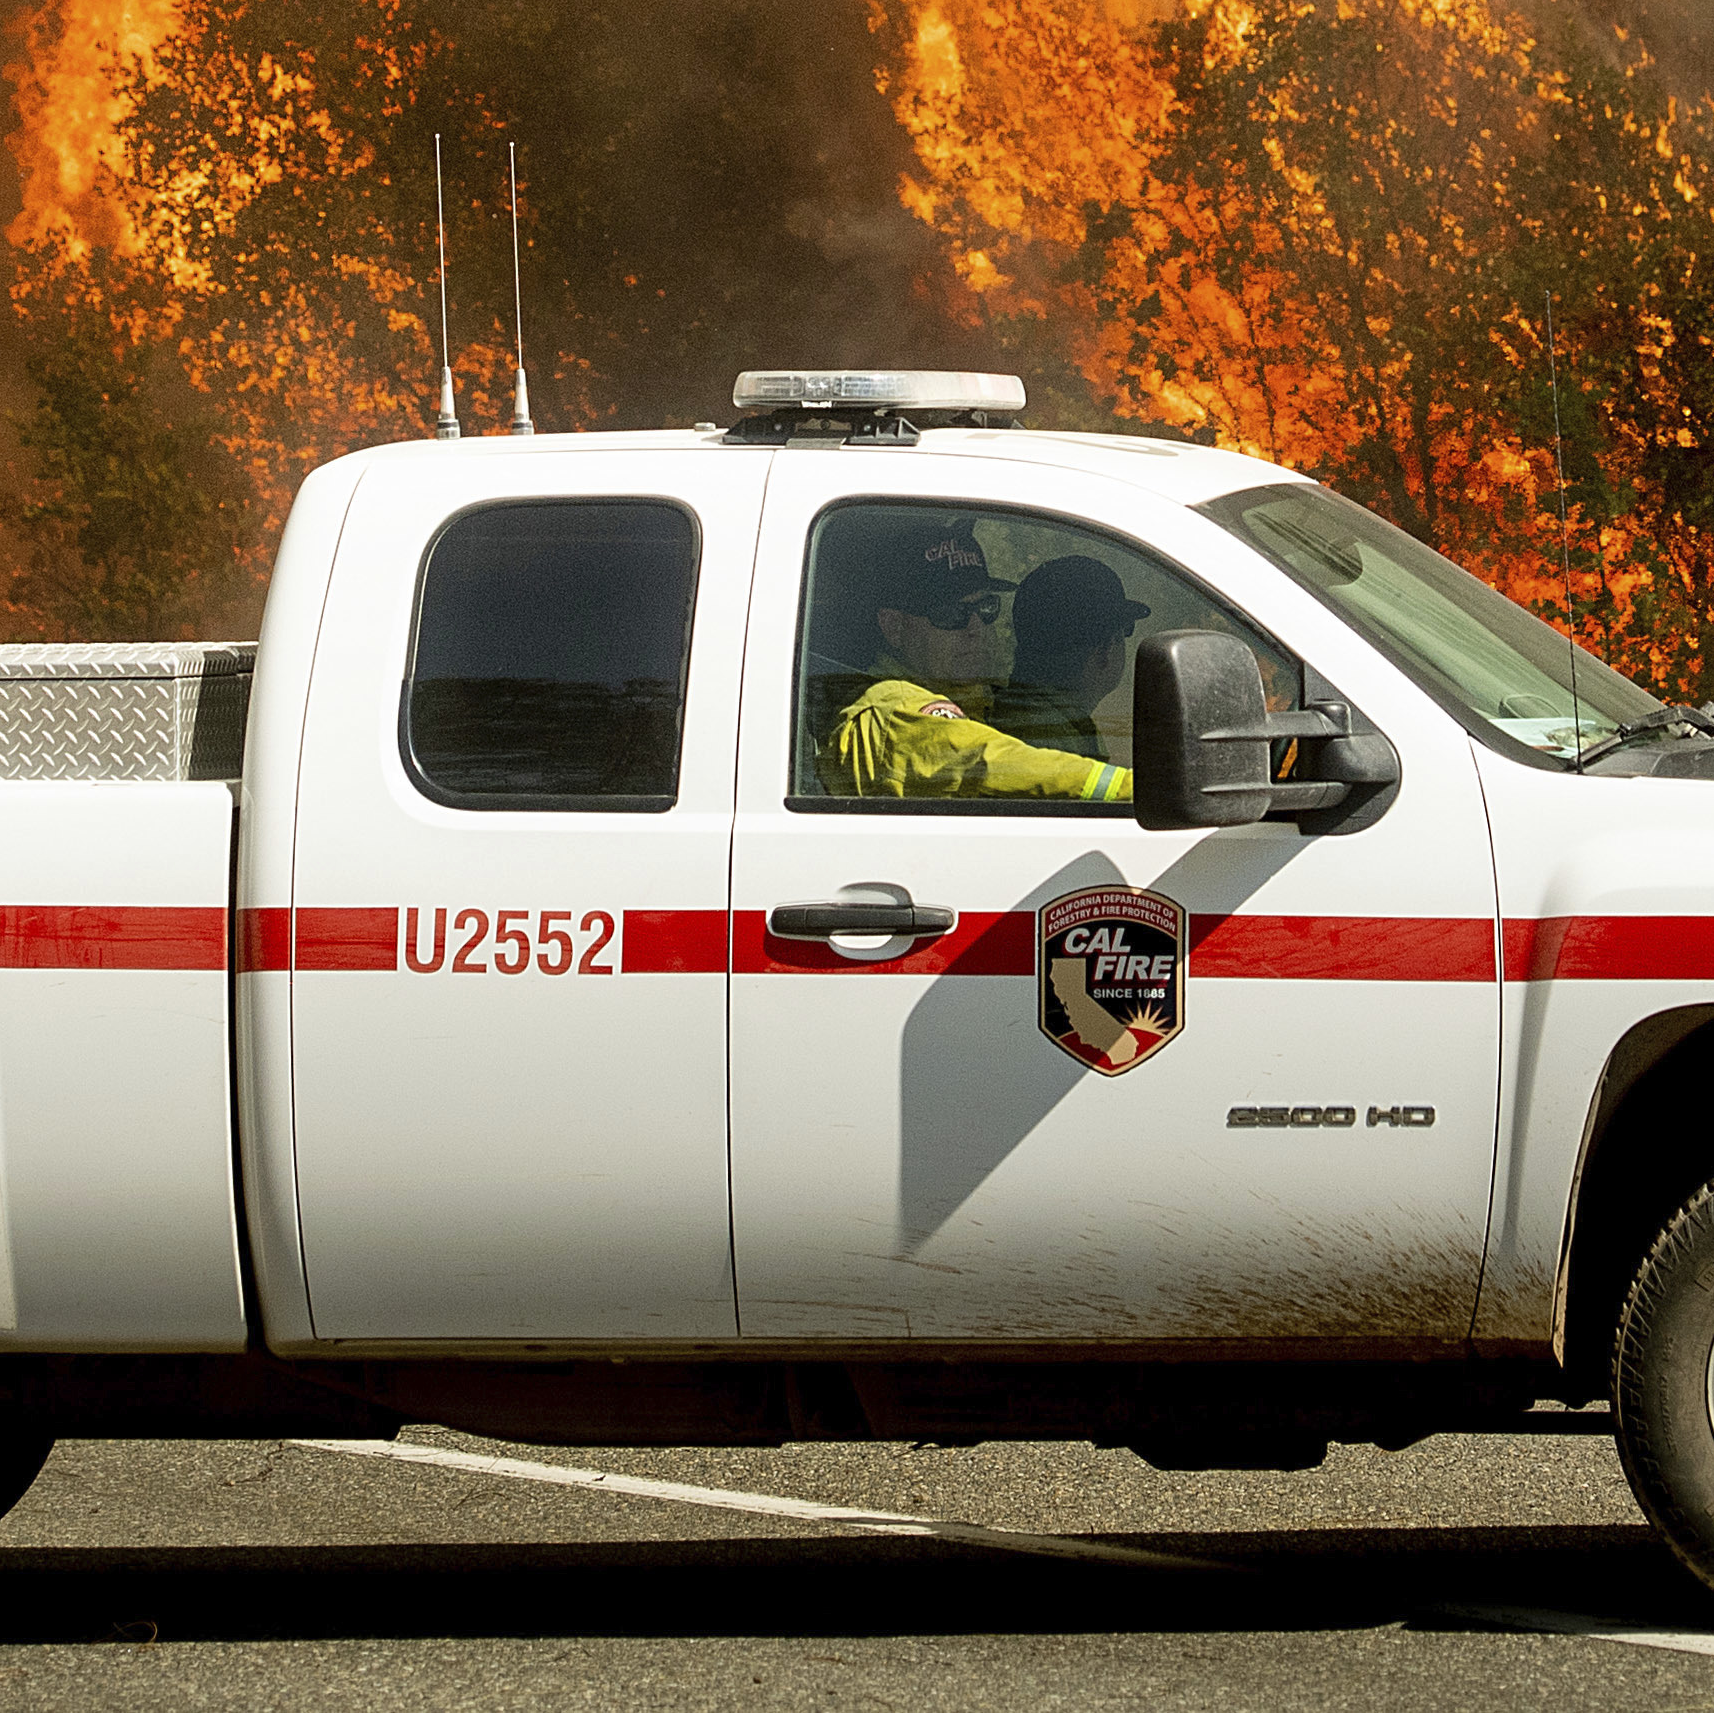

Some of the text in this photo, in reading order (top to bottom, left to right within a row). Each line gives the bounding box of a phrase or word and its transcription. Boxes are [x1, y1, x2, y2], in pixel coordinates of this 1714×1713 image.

[1048, 906, 1176, 933] FORESTRY & FIRE PROTECTION
[1050, 894, 1174, 920] CALIFORNIA DEPARTMENT OF
[405, 908, 615, 975] U2552
[1064, 927, 1131, 954] CAL
[1094, 955, 1174, 981] FIRE
[1093, 988, 1165, 998] SINCE 1885
[1366, 1106, 1435, 1127] HD
